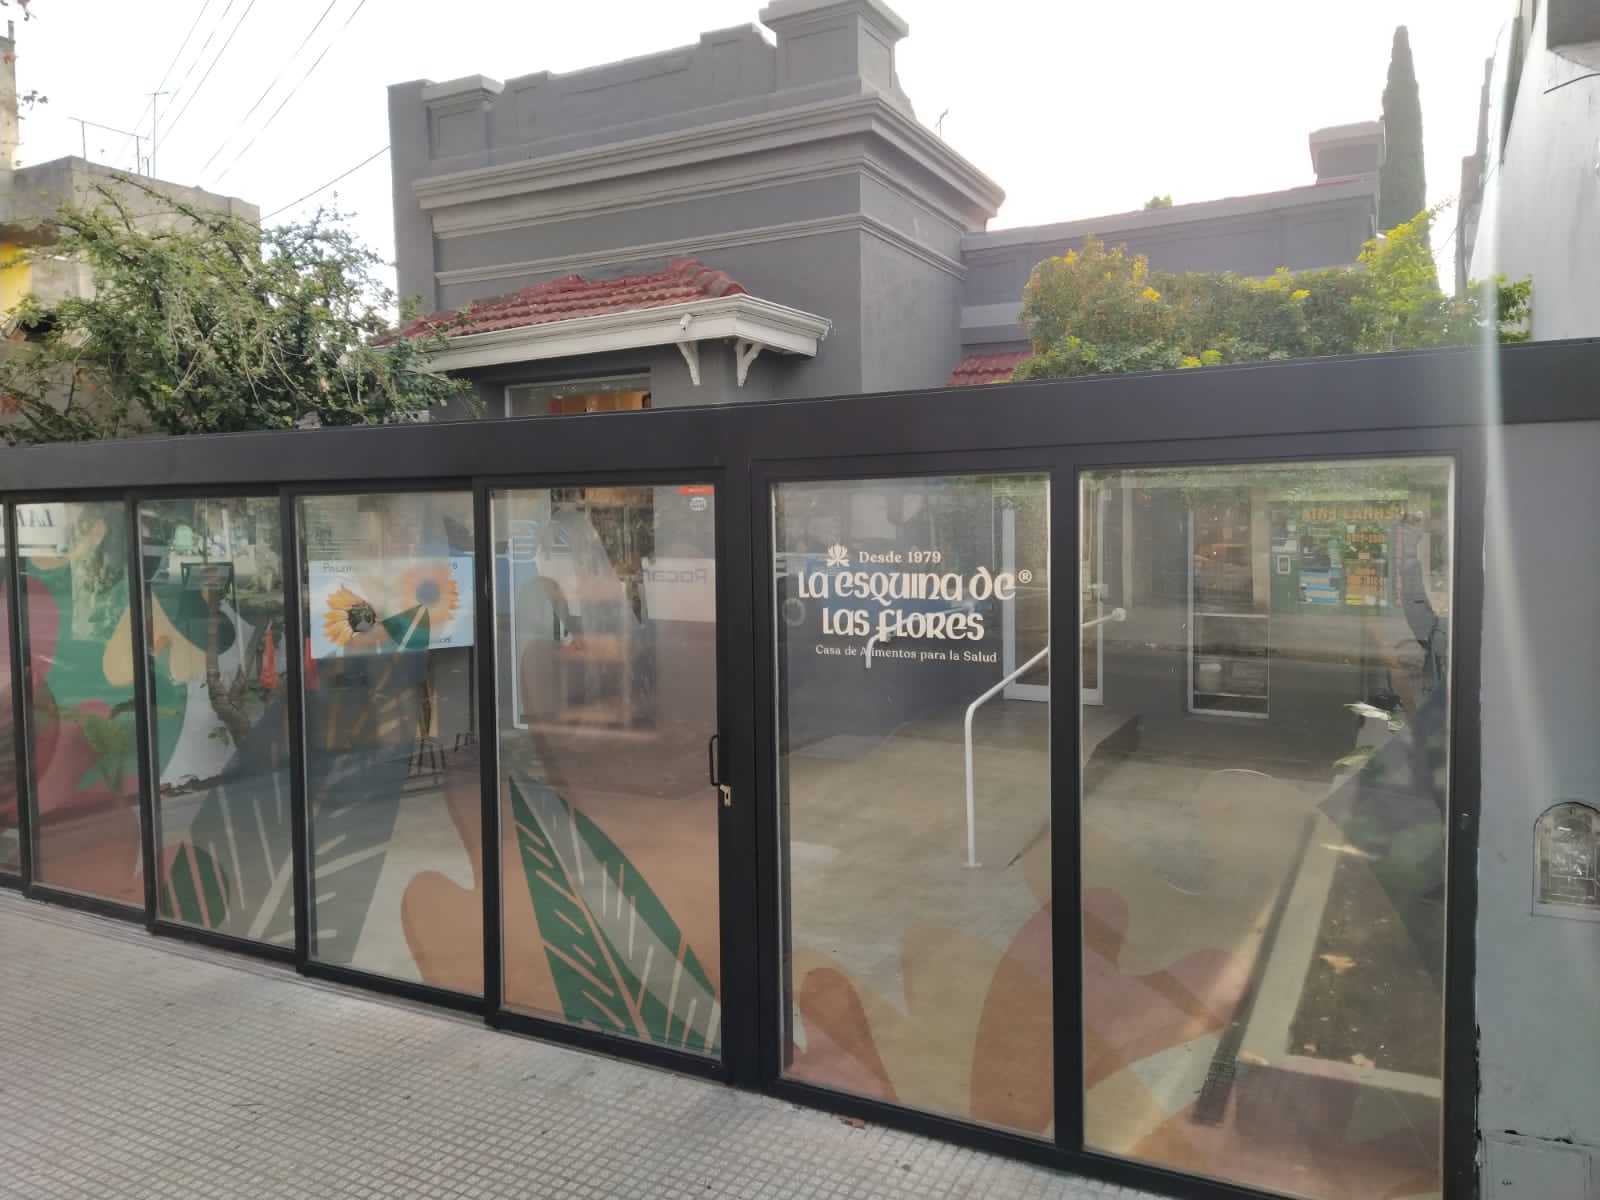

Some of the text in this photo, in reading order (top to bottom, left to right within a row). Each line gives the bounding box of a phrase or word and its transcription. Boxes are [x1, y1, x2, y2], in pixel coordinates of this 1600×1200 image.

[858, 551, 942, 564] Desde 1979
[815, 644, 842, 656] Casa
[844, 645, 858, 656] de
[919, 649, 947, 662] para
[949, 649, 960, 661] la
[963, 652, 997, 663] Salud
